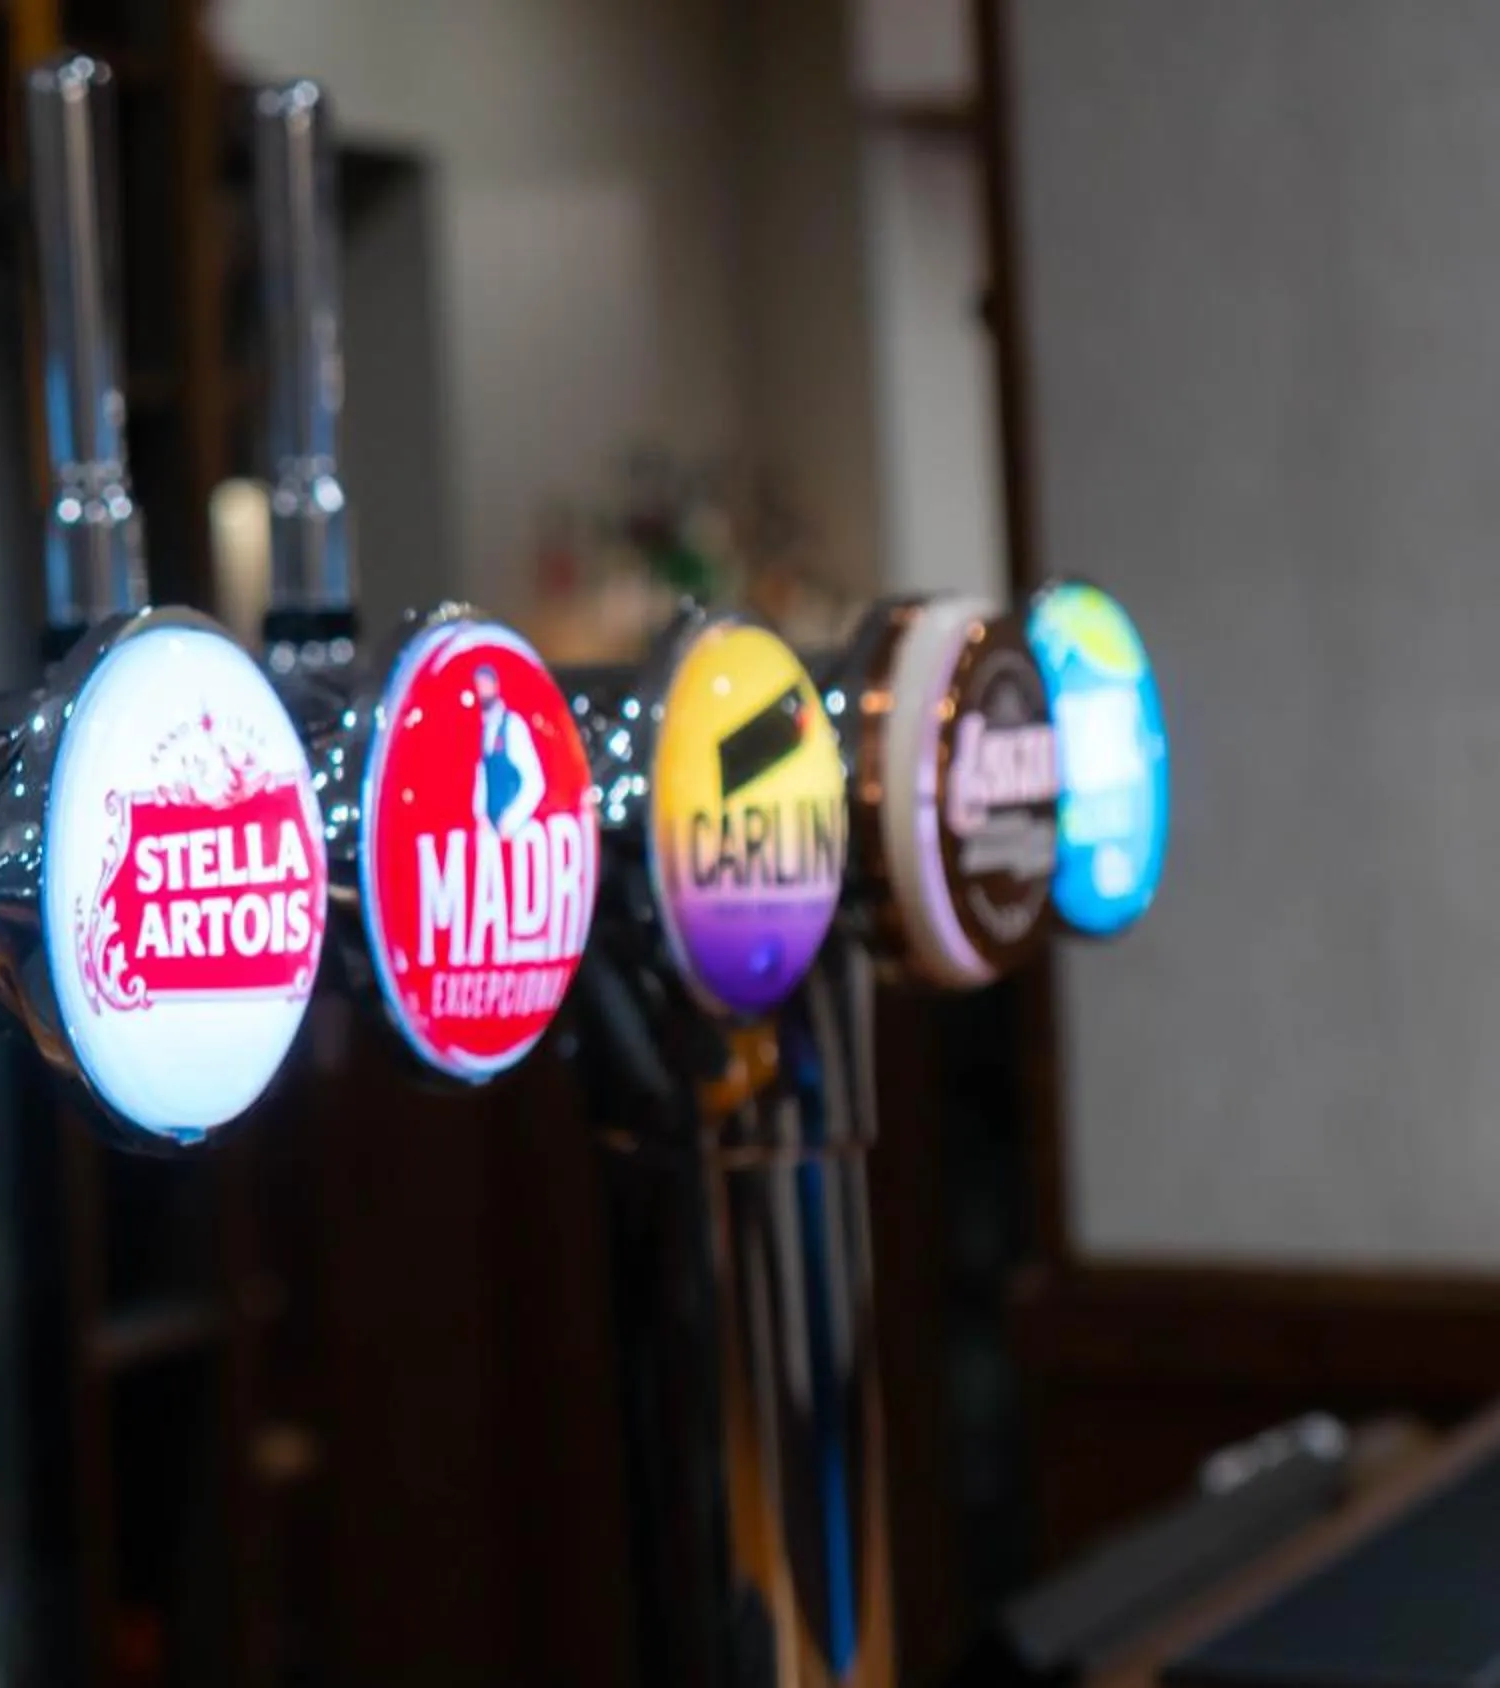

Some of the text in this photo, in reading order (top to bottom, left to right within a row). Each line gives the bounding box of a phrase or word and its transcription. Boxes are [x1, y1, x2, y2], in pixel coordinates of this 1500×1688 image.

[134, 817, 311, 896] STELLA
[689, 796, 848, 888] CARLIN
[134, 889, 311, 959] ARTOIS
